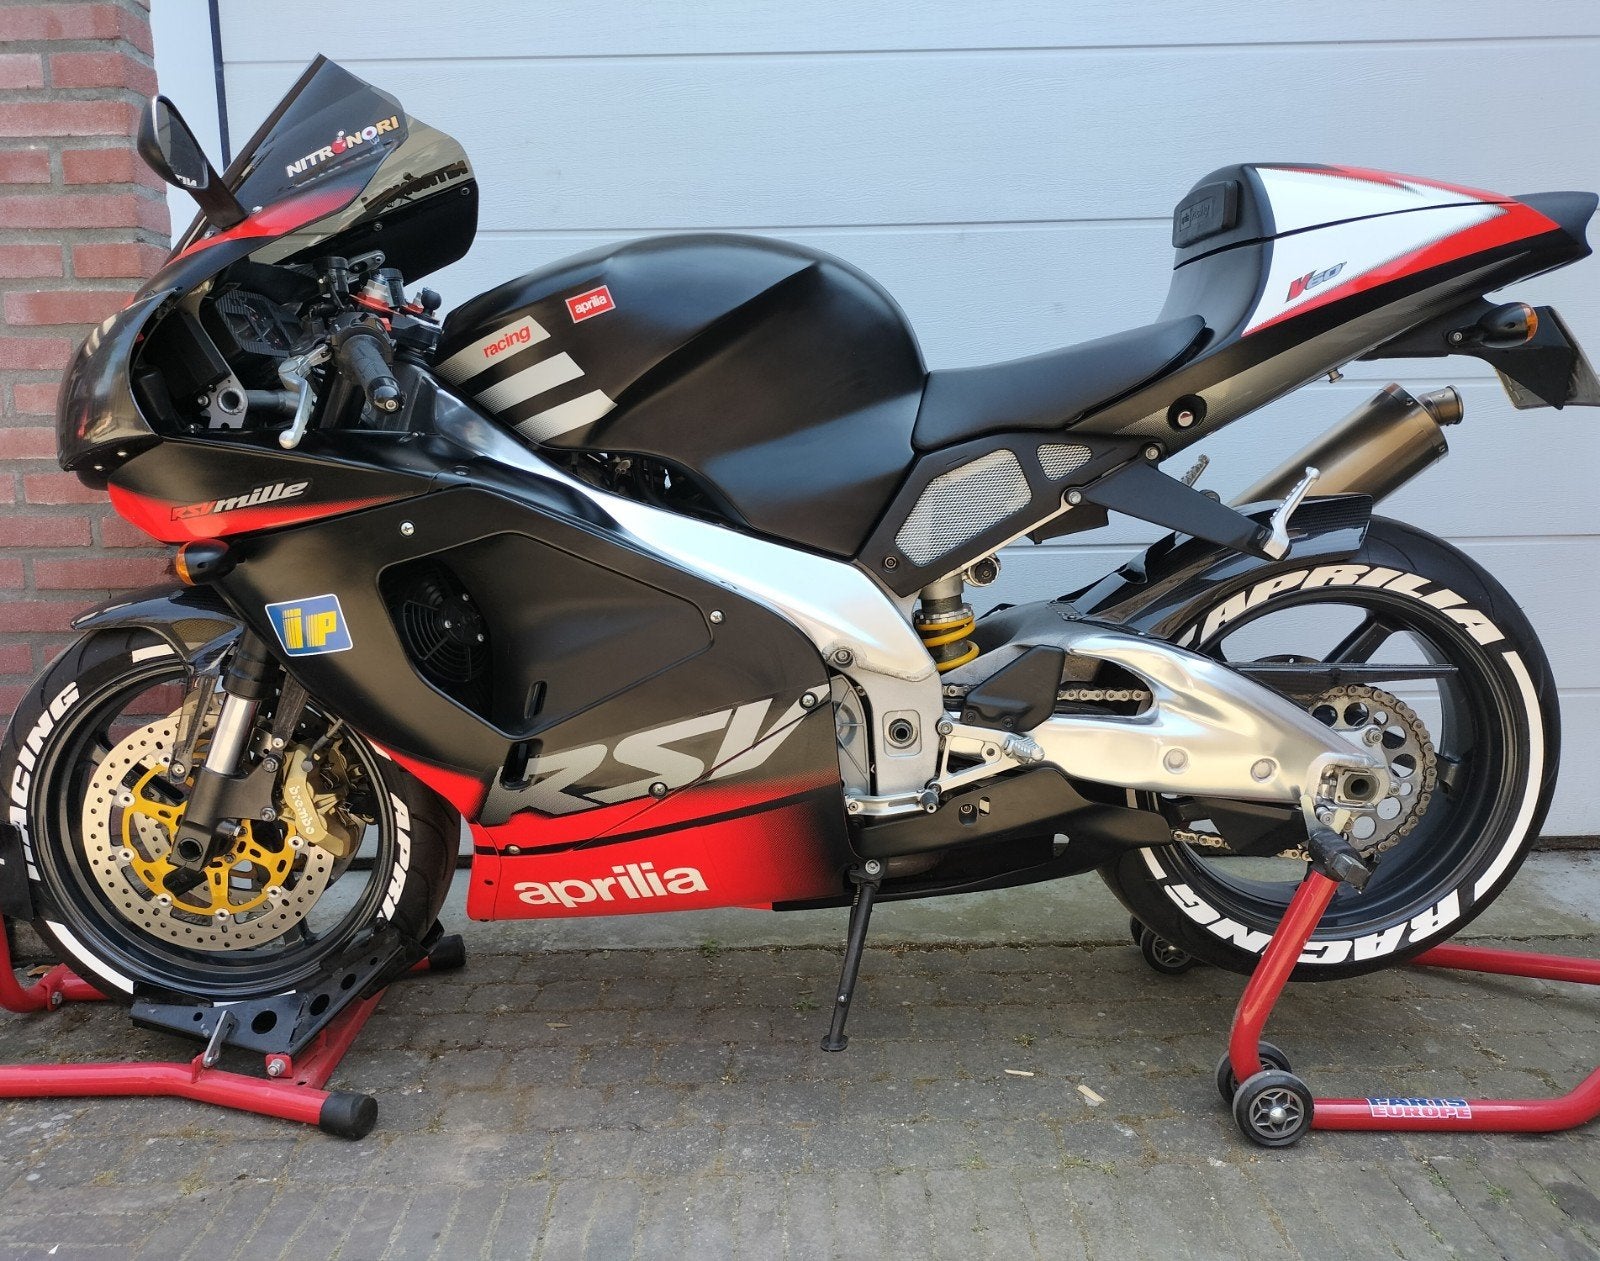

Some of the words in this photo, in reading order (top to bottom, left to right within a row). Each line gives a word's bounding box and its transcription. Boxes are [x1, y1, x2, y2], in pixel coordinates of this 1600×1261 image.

[574, 292, 608, 315] aprilia
[482, 325, 532, 359] racing
[1197, 564, 1506, 648] APRILIA
[289, 785, 315, 835] brembo
[513, 861, 709, 908] aprilia
[1163, 883, 1461, 964] RACNG
[1371, 1104, 1473, 1119] EUROPE
